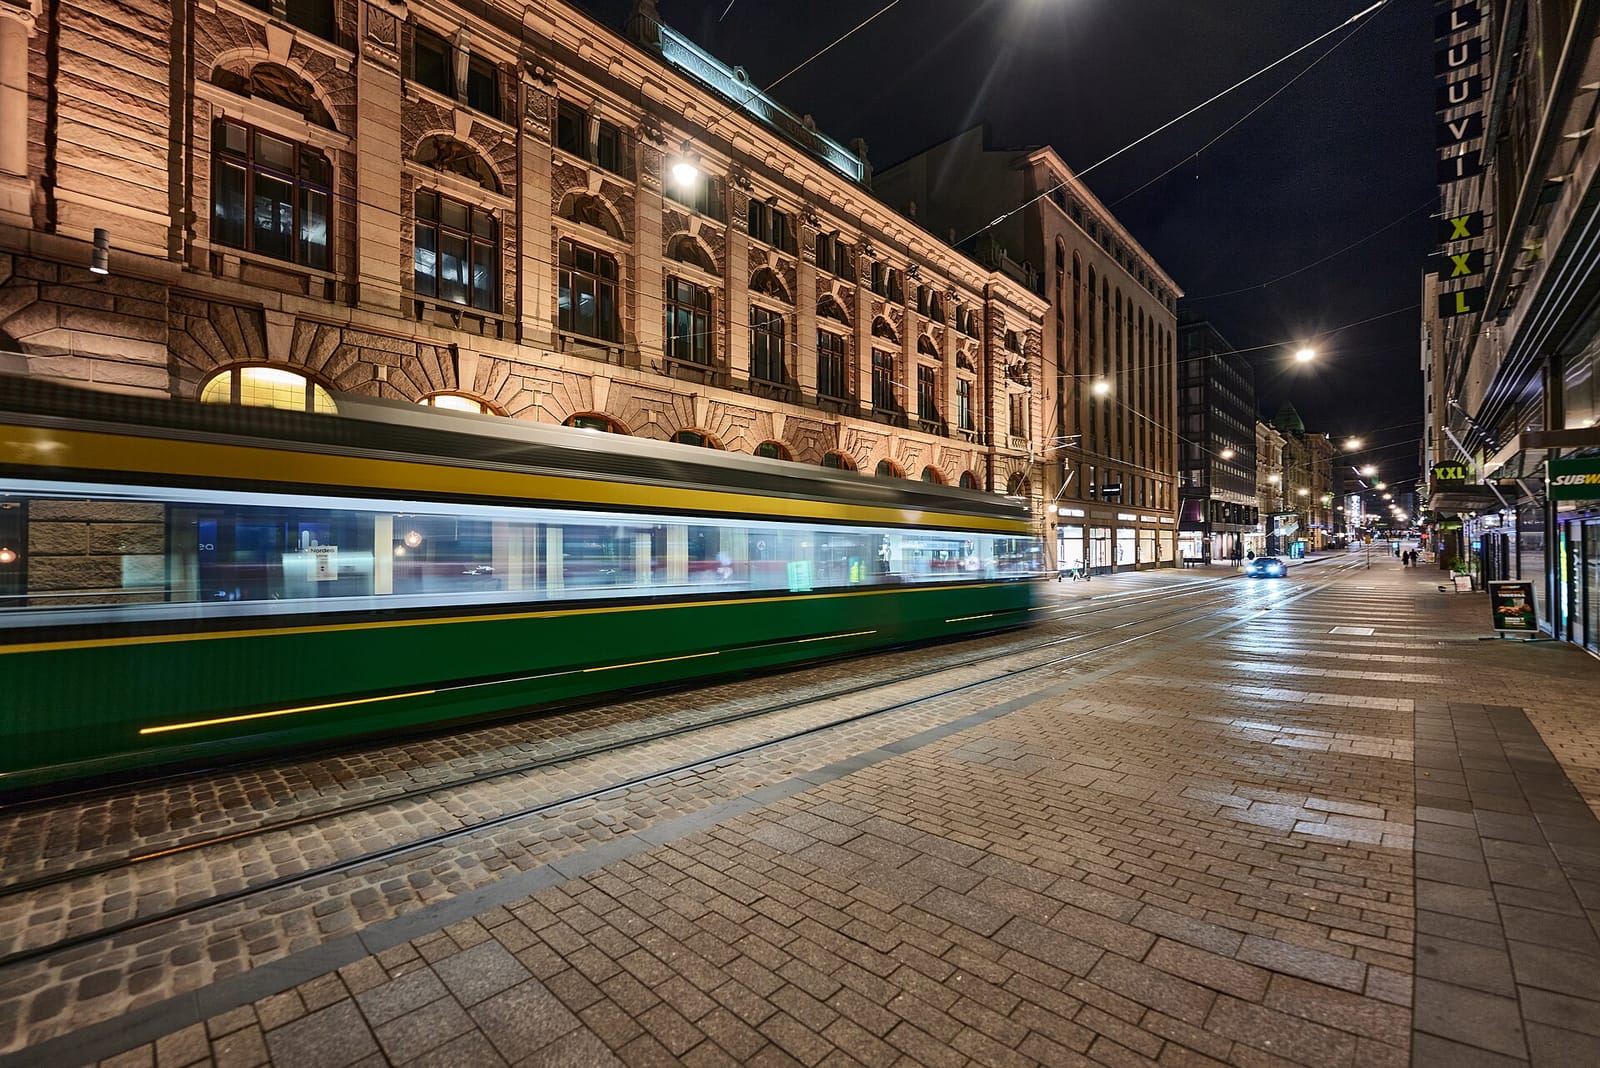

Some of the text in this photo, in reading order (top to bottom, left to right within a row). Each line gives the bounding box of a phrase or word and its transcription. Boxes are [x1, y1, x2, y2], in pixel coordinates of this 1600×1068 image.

[1450, 215, 1471, 314] XXL
[1434, 467, 1465, 479] XXL
[1551, 474, 1600, 485] SUBW
